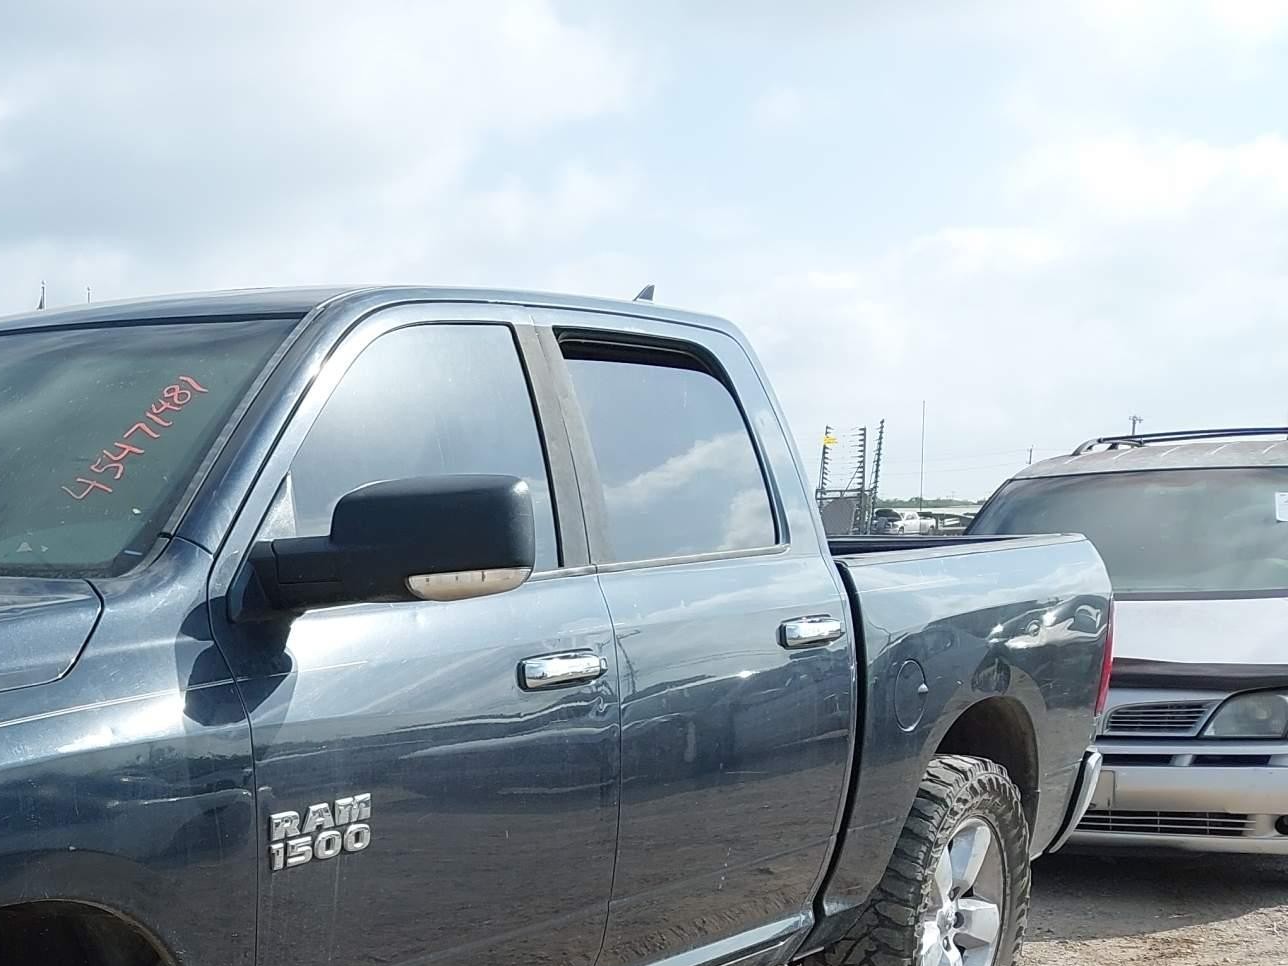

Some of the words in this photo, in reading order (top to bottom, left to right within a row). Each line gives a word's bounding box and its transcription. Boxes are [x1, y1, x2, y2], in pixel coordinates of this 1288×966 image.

[62, 375, 208, 499] 45471481
[269, 792, 371, 841] RAM
[270, 823, 371, 871] 1500
